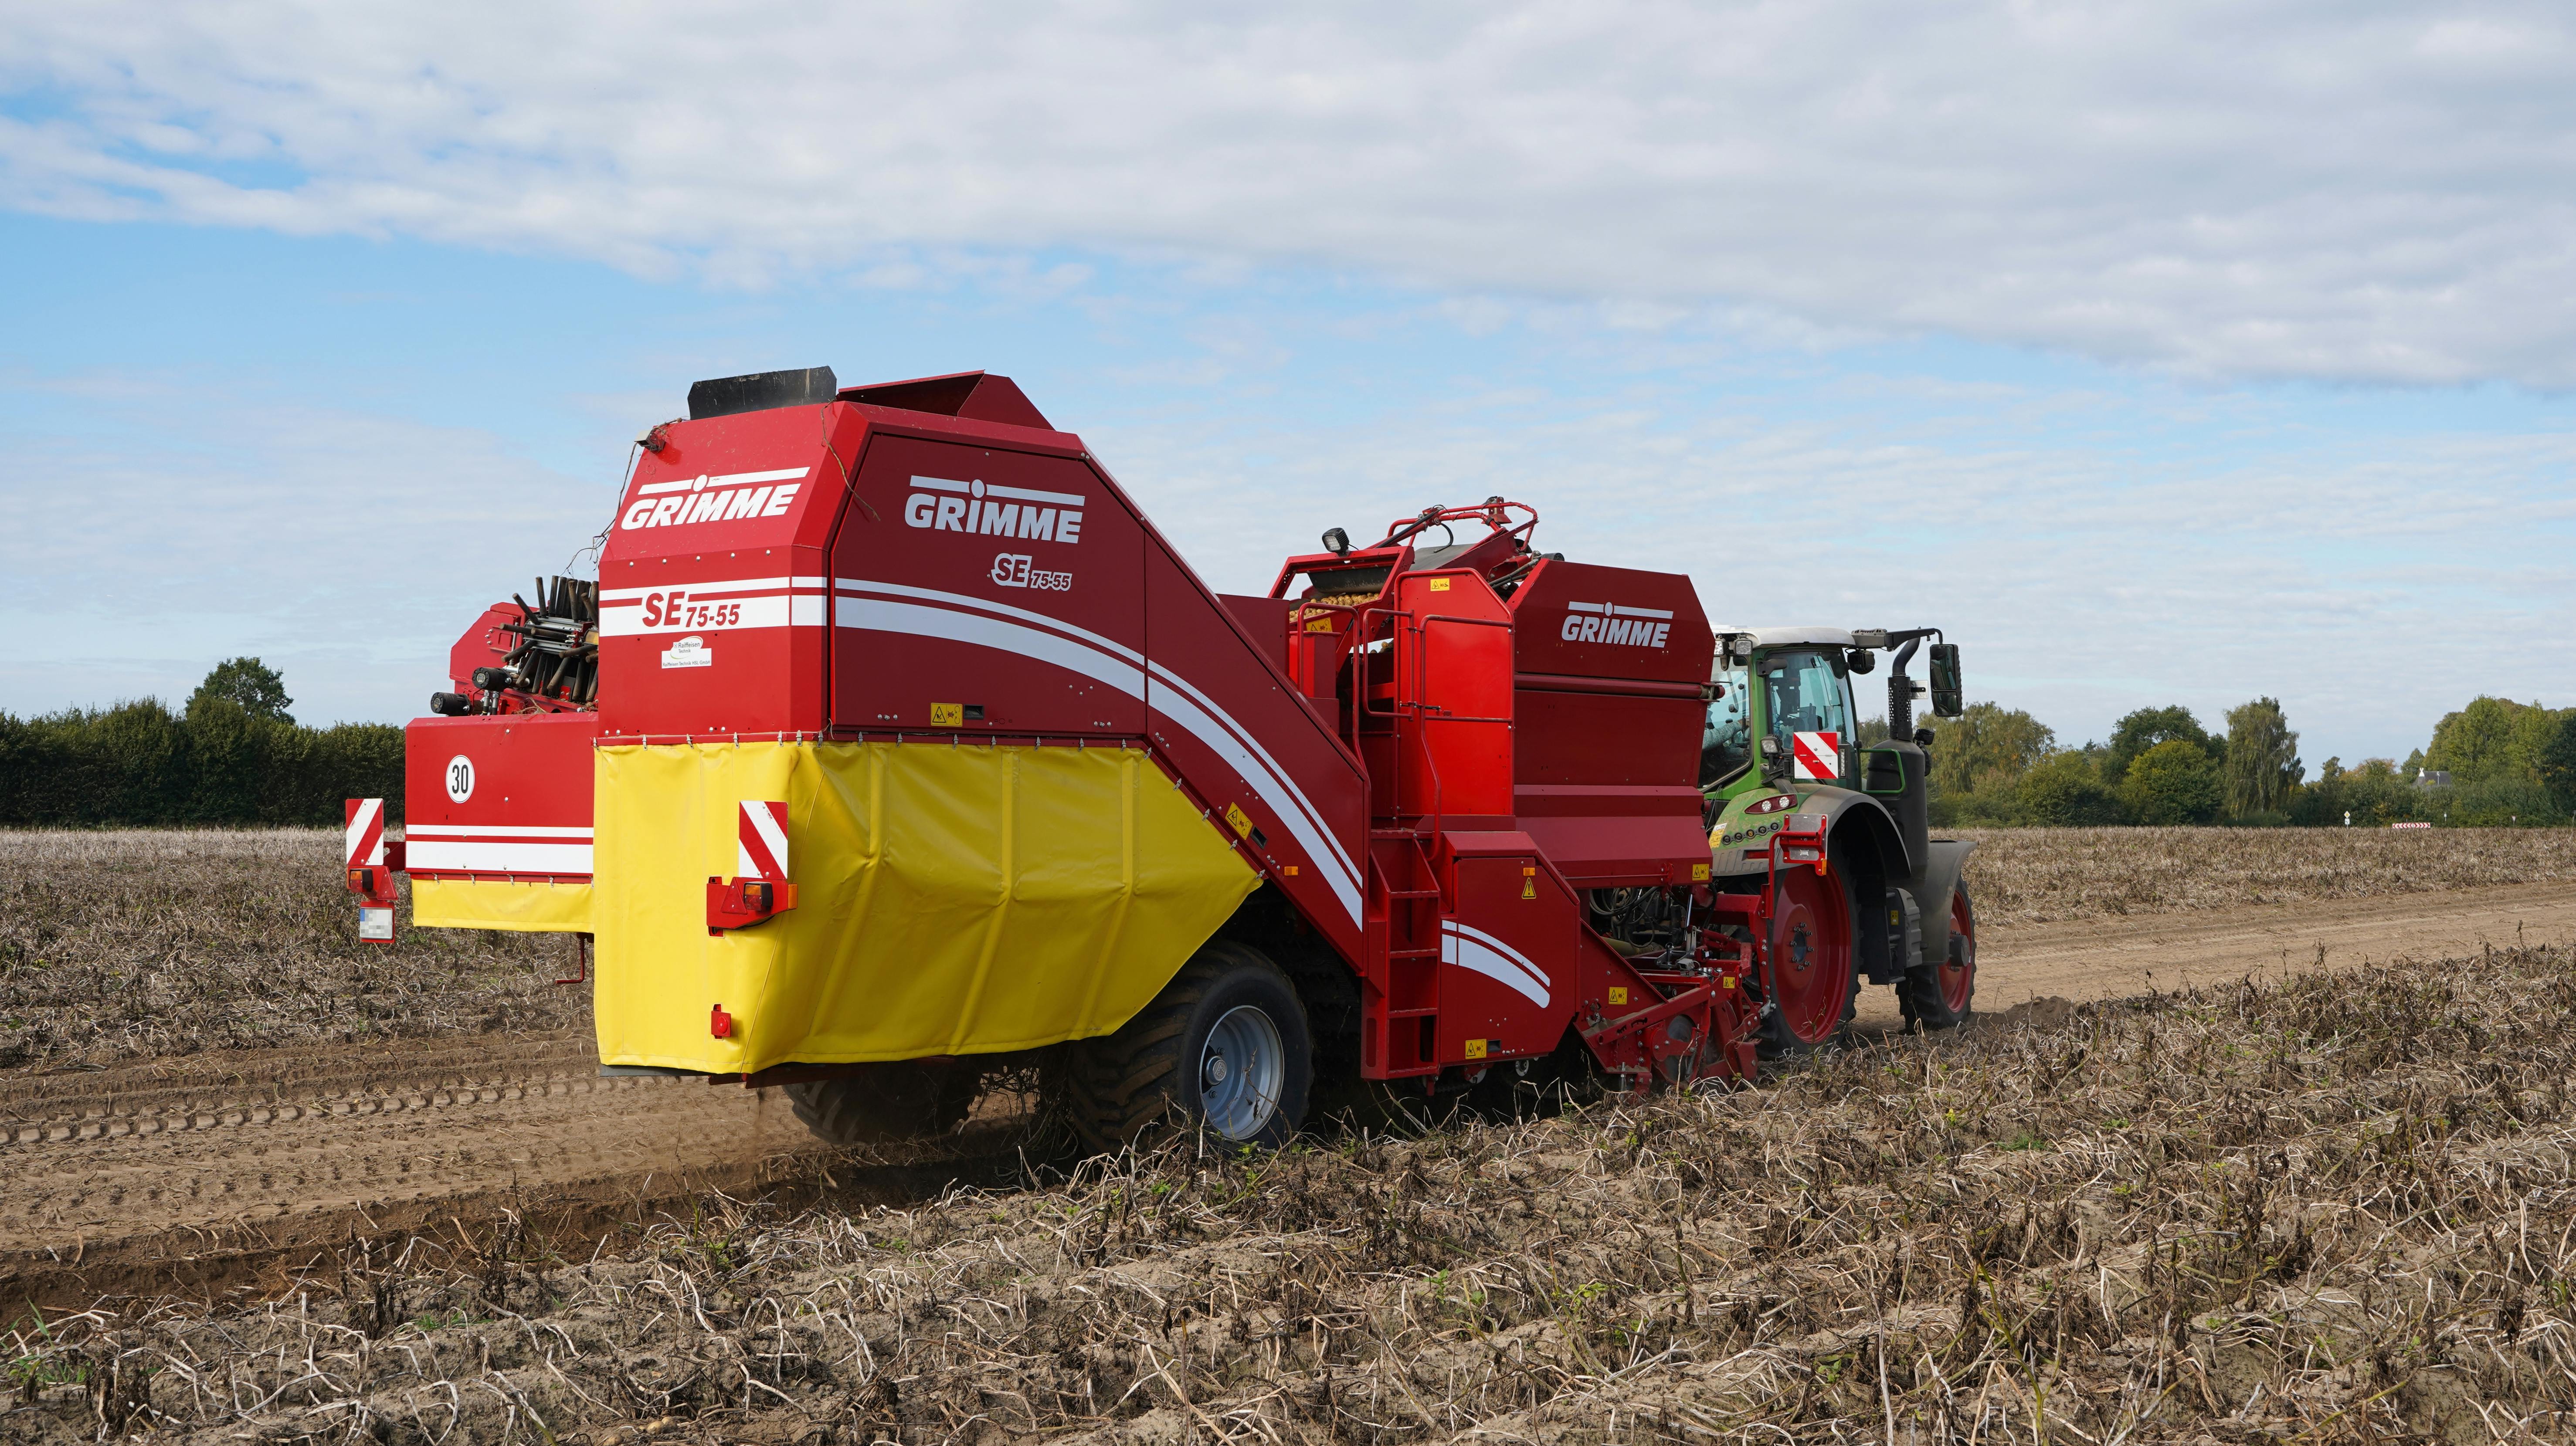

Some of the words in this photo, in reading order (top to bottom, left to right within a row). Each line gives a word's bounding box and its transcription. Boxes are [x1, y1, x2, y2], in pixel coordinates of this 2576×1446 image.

[621, 475, 801, 530] GRIMME
[905, 479, 1083, 543] GRIMME
[993, 555, 1030, 585] SE
[1032, 572, 1071, 589] 75-55
[642, 591, 685, 627] SE
[686, 604, 740, 627] 75-55
[1561, 602, 1670, 648] GRIMME
[452, 764, 468, 794] 30
